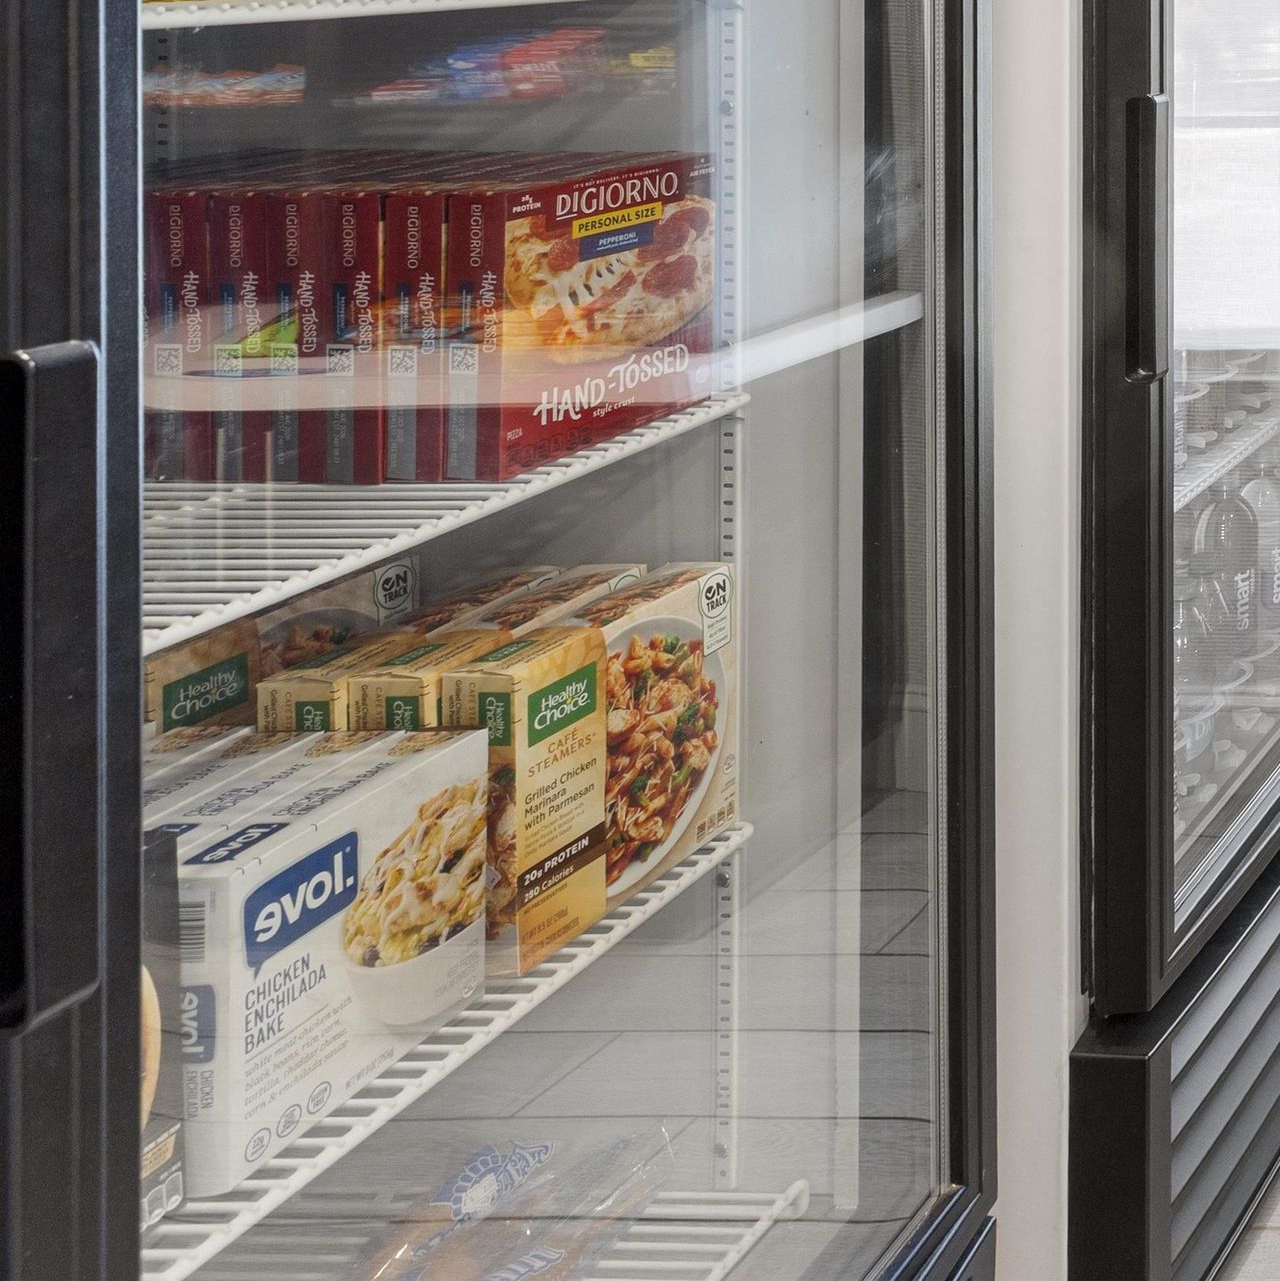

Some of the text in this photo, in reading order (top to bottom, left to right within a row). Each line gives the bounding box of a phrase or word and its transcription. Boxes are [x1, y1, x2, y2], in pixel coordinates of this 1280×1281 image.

[512, 202, 542, 213] PROTEIN
[578, 206, 656, 233] PERSONAL SIZE
[169, 205, 183, 268] DIGIORNO
[229, 205, 242, 268] DIGIORNO
[286, 204, 298, 267] DIGIORNO
[342, 204, 355, 267] DIGIORNO
[407, 206, 419, 269] DIGIORNO
[470, 204, 483, 267] DIGIORNO
[599, 231, 637, 246] PEPPERONI
[182, 270, 202, 354] HAND-TOSSED
[241, 270, 262, 355] HAND-TOSSED
[297, 270, 318, 354] HAND-TOSSED
[355, 270, 373, 354] HAND-TOSSED
[418, 272, 436, 356] HAND-TOSSED
[481, 270, 498, 354] HAND-TOSSED
[533, 343, 690, 426] HAND-TOSSED
[592, 396, 636, 418] style crust
[384, 585, 409, 605] TRACK
[705, 578, 727, 600] ON
[706, 594, 727, 613] TRACK
[1234, 569, 1250, 631] smart
[171, 683, 240, 721] Choice
[179, 669, 236, 703] Healthy
[541, 679, 588, 711] Healthy
[528, 734, 592, 778] STEAMERS
[548, 727, 579, 754] CAFÉ
[524, 756, 597, 806] Grilled Chicken
[524, 787, 567, 819] Marinara
[524, 813, 546, 831] with
[548, 782, 595, 815] Parmesan
[524, 836, 590, 886] 20g PROTEIN
[524, 865, 574, 903] 280 Calories
[244, 964, 327, 1033] ENCHILADA
[245, 953, 311, 1011] CHICKEN
[244, 1013, 285, 1055] BAKE
